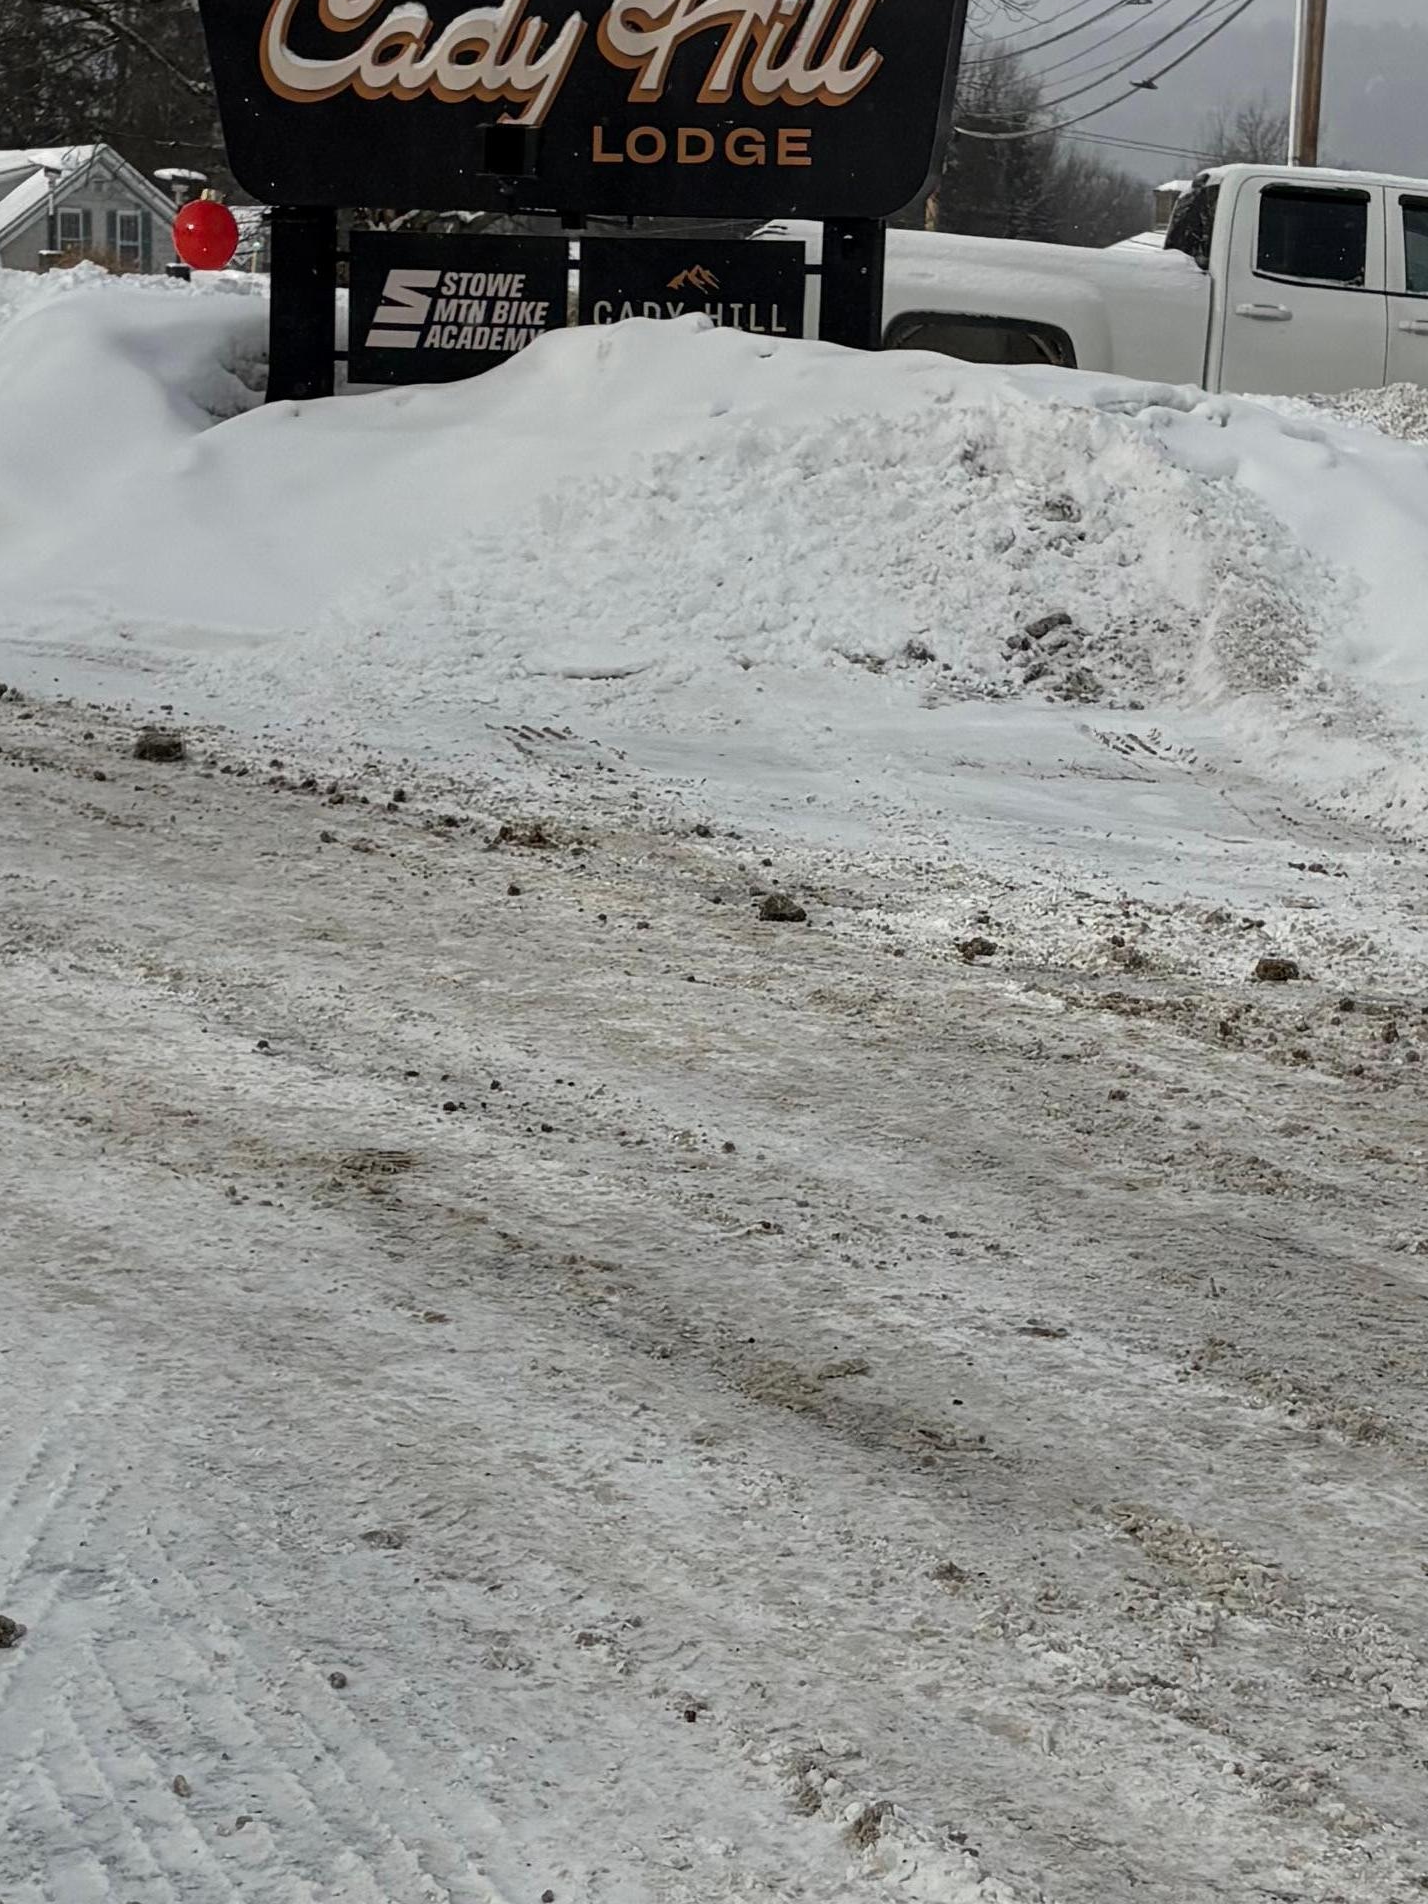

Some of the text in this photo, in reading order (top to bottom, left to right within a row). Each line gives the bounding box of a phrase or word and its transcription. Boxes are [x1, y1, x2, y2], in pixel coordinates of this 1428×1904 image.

[592, 126, 813, 166] LODGE
[441, 272, 526, 297] STOWE
[433, 299, 550, 325] MTN BIKE
[705, 302, 787, 332] HILL
